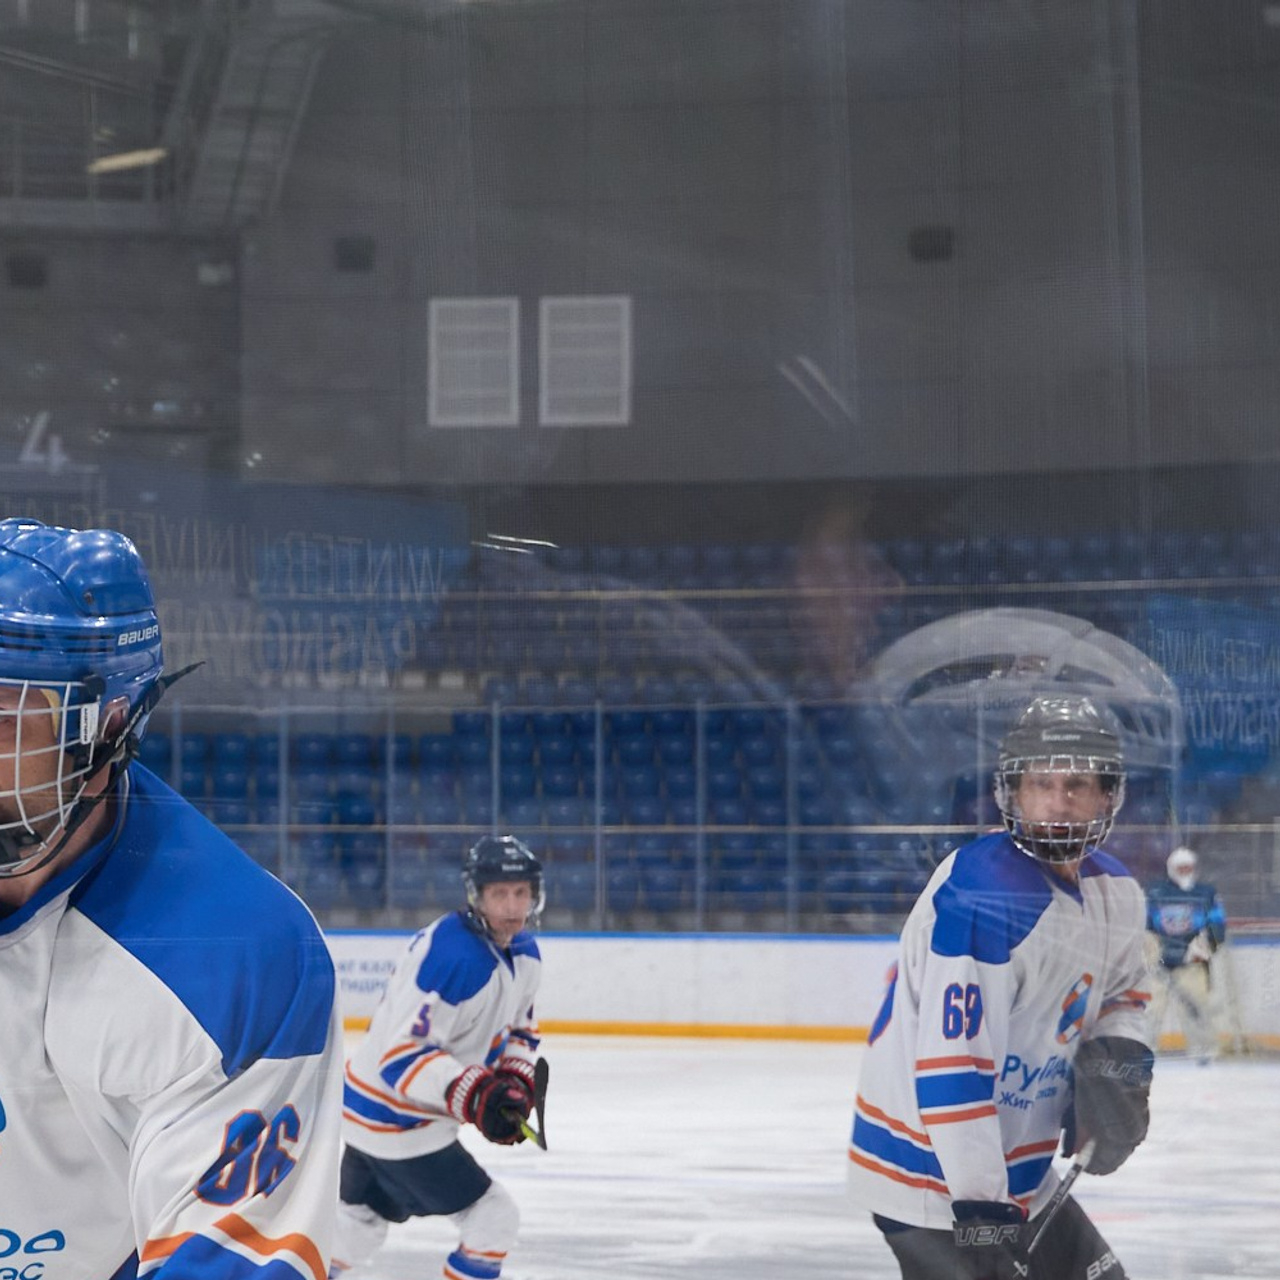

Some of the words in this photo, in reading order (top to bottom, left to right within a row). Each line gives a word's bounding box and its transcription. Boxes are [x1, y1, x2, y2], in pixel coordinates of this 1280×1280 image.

[411, 1003, 432, 1038] 5
[942, 982, 984, 1040] 69
[192, 1101, 304, 1207] 86
